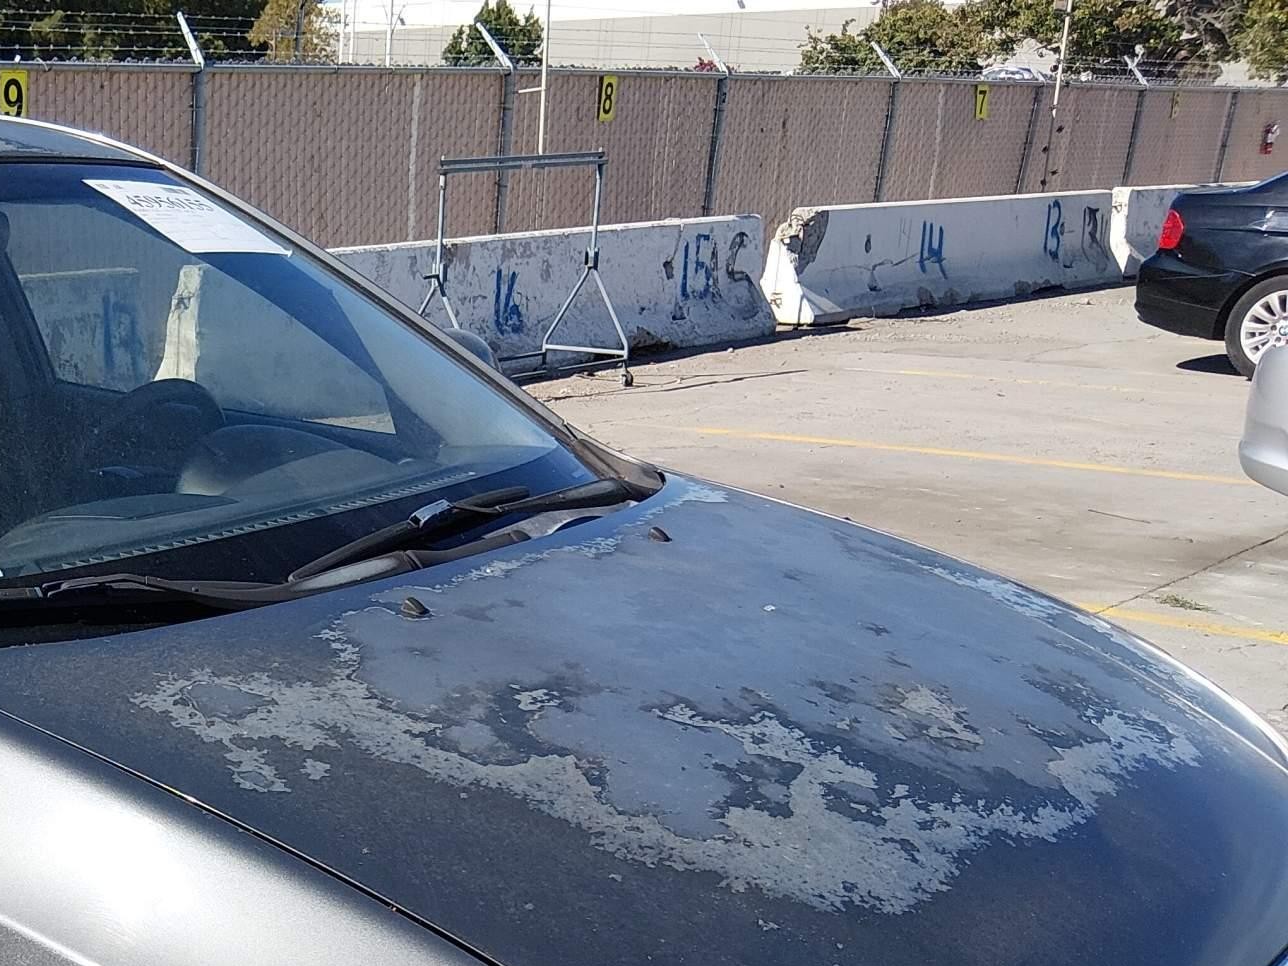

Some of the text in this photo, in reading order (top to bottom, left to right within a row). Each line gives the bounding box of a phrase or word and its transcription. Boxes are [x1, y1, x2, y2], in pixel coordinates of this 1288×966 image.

[4, 78, 23, 117] 9
[603, 82, 613, 114] 8
[979, 90, 987, 114] 7
[126, 195, 215, 212] 45956155
[917, 220, 948, 280] 14
[1043, 199, 1061, 264] 13
[680, 233, 711, 300] 15
[494, 266, 524, 334] 16
